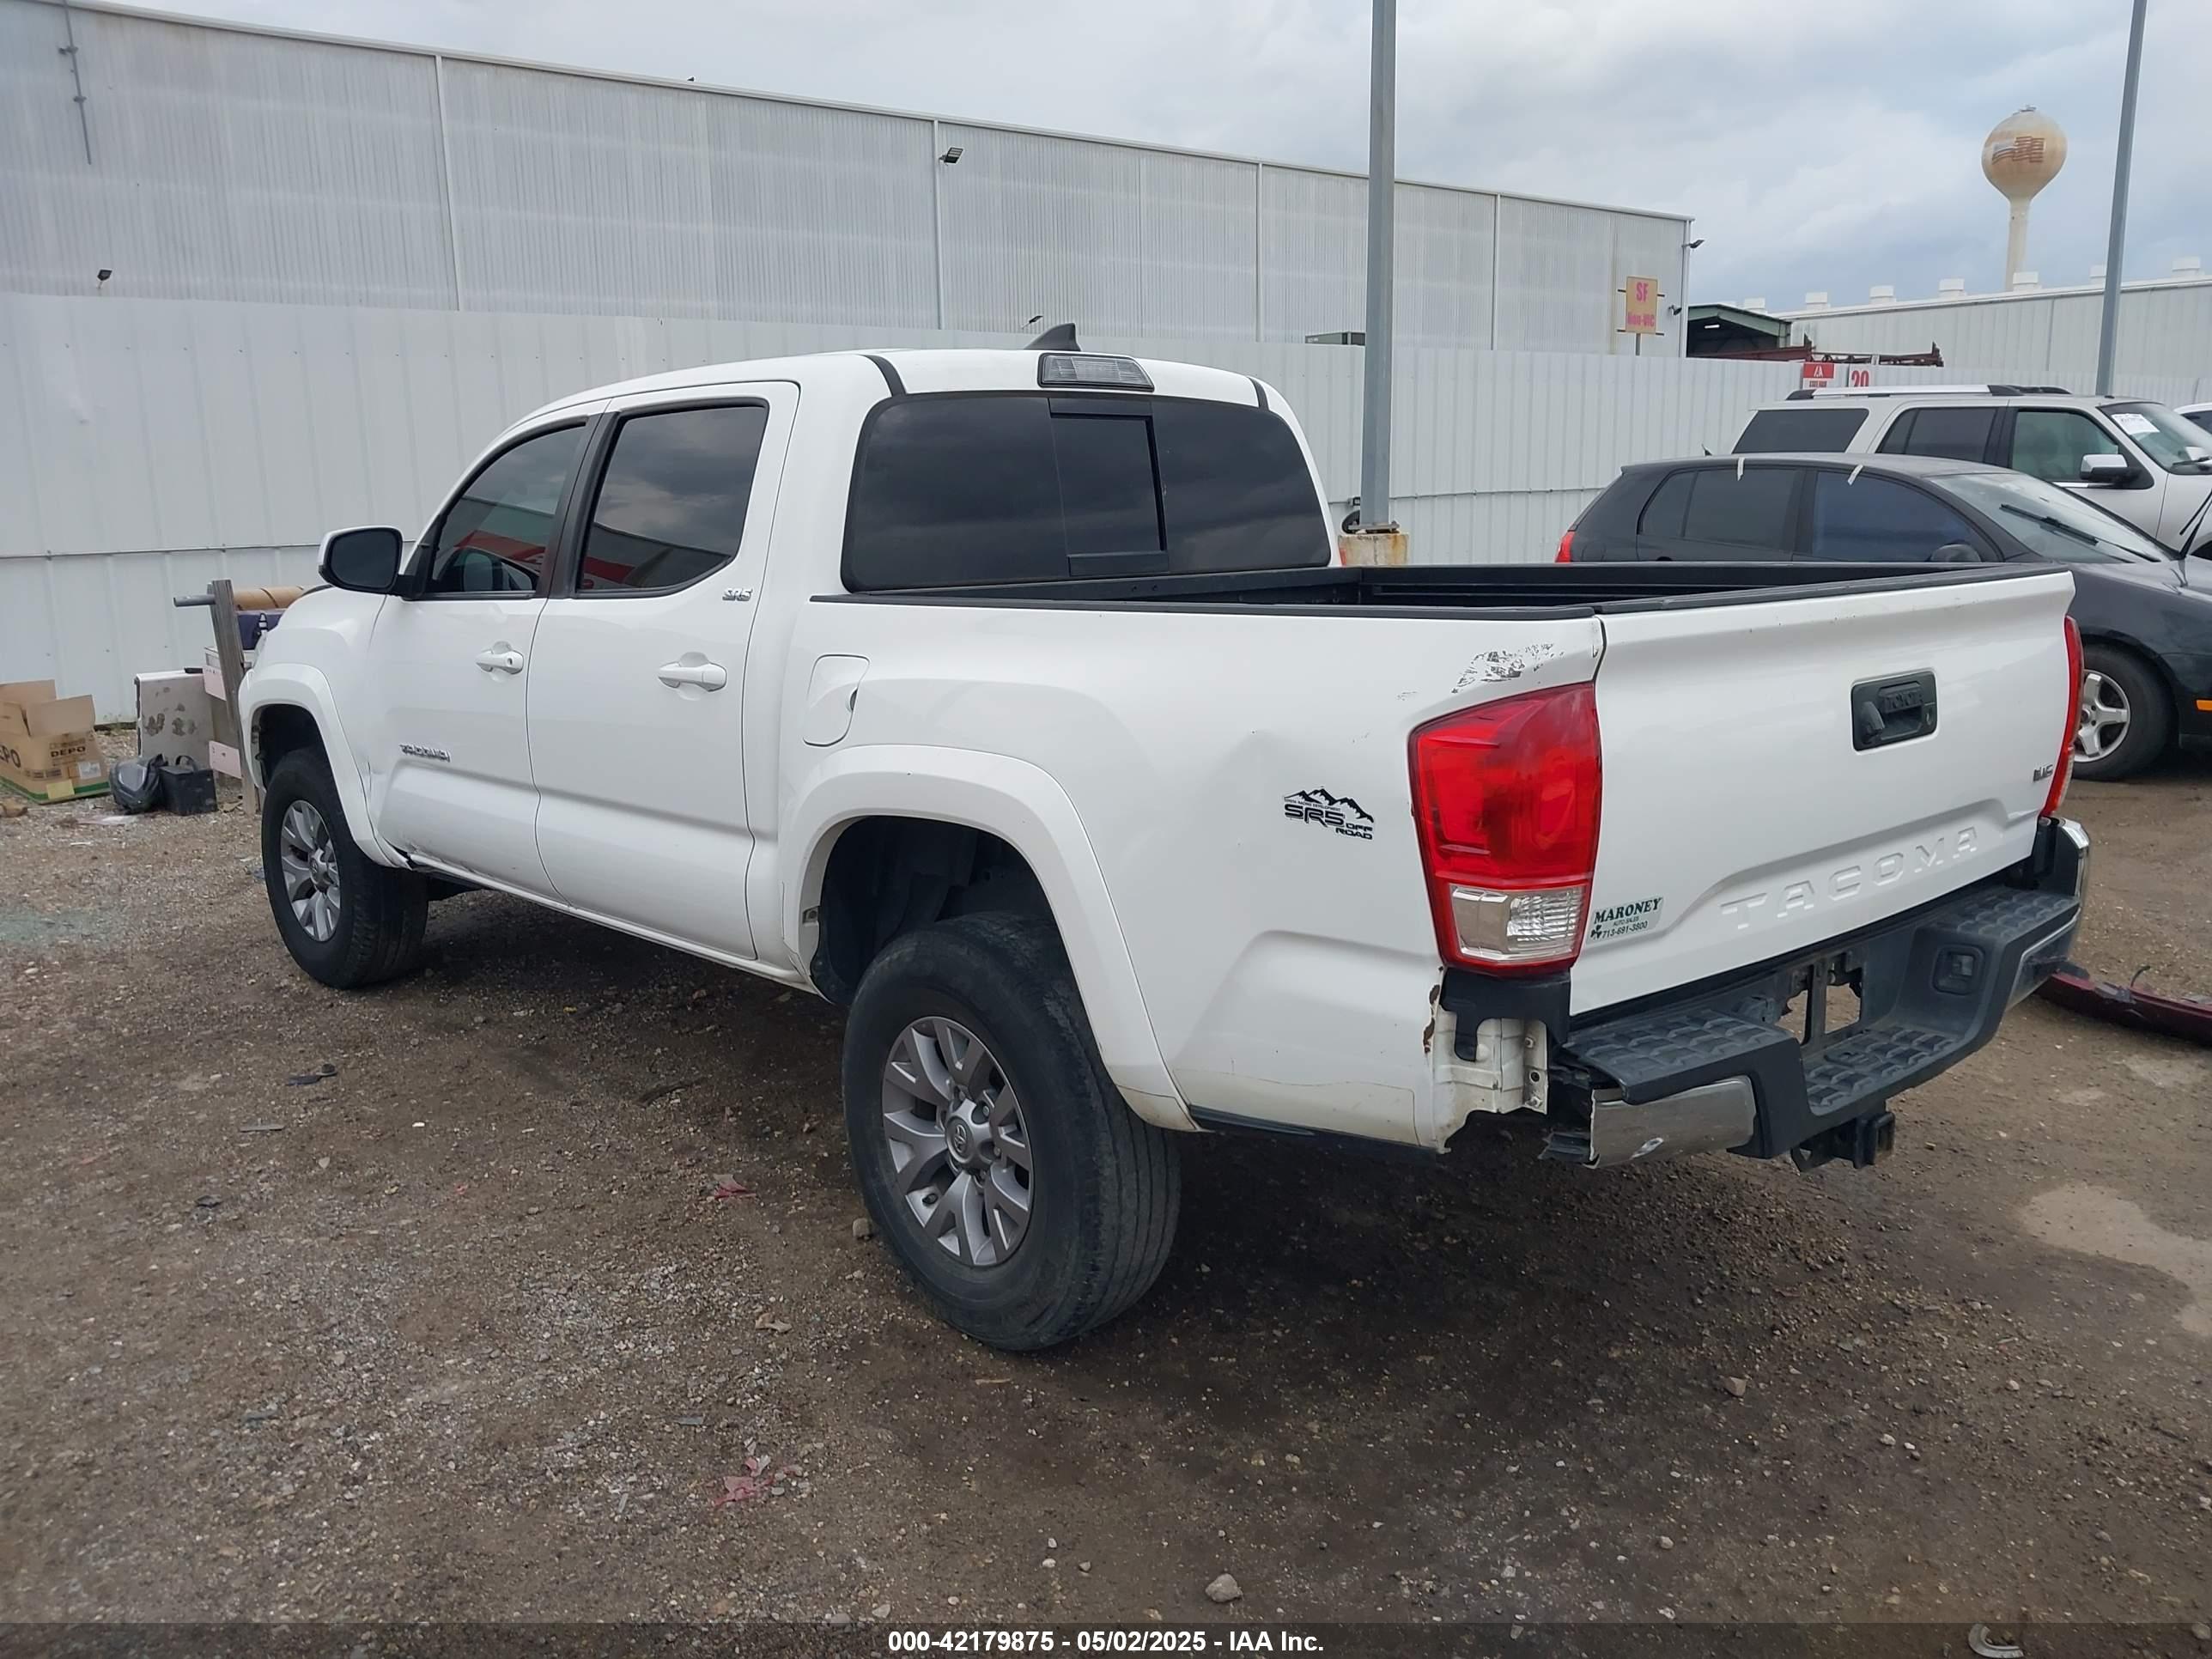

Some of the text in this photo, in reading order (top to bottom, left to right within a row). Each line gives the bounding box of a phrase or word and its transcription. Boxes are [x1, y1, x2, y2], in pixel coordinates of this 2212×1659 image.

[1636, 282, 1649, 302] SF
[1851, 370, 1869, 387] 20
[50, 745, 86, 757] DEPO
[1284, 803, 1373, 832] SR5 OFF
[1335, 827, 1373, 841] ROAD
[1720, 826, 1978, 930] TACOMA
[1594, 897, 1662, 924] MARONEY
